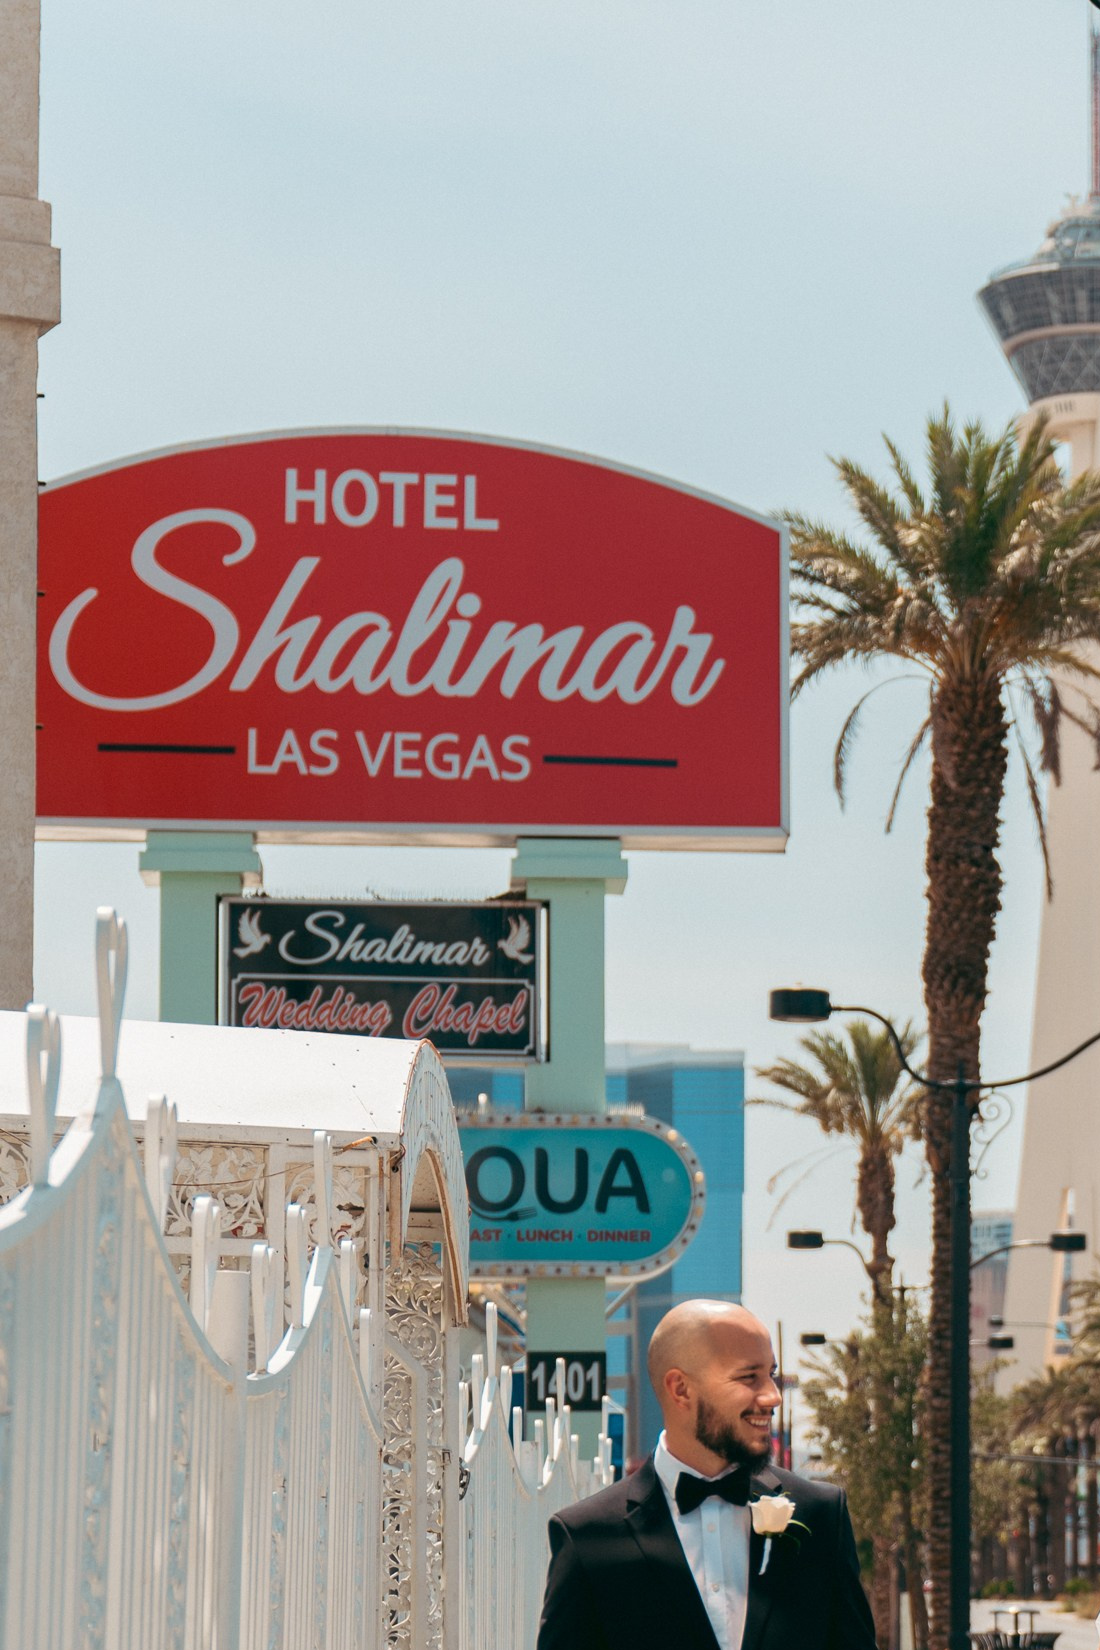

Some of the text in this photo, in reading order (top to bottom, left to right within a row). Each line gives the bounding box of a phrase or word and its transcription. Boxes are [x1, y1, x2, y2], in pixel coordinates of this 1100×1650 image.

[285, 468, 499, 530] HOTEL
[48, 507, 725, 712] Shalimar
[247, 728, 532, 782] LAS VEGAS
[278, 910, 492, 967] Shalimar
[238, 981, 529, 1046] Wedding Chapel
[464, 1145, 651, 1222] QUA
[516, 1229, 574, 1242] LUNCH
[586, 1229, 651, 1242] DINNER
